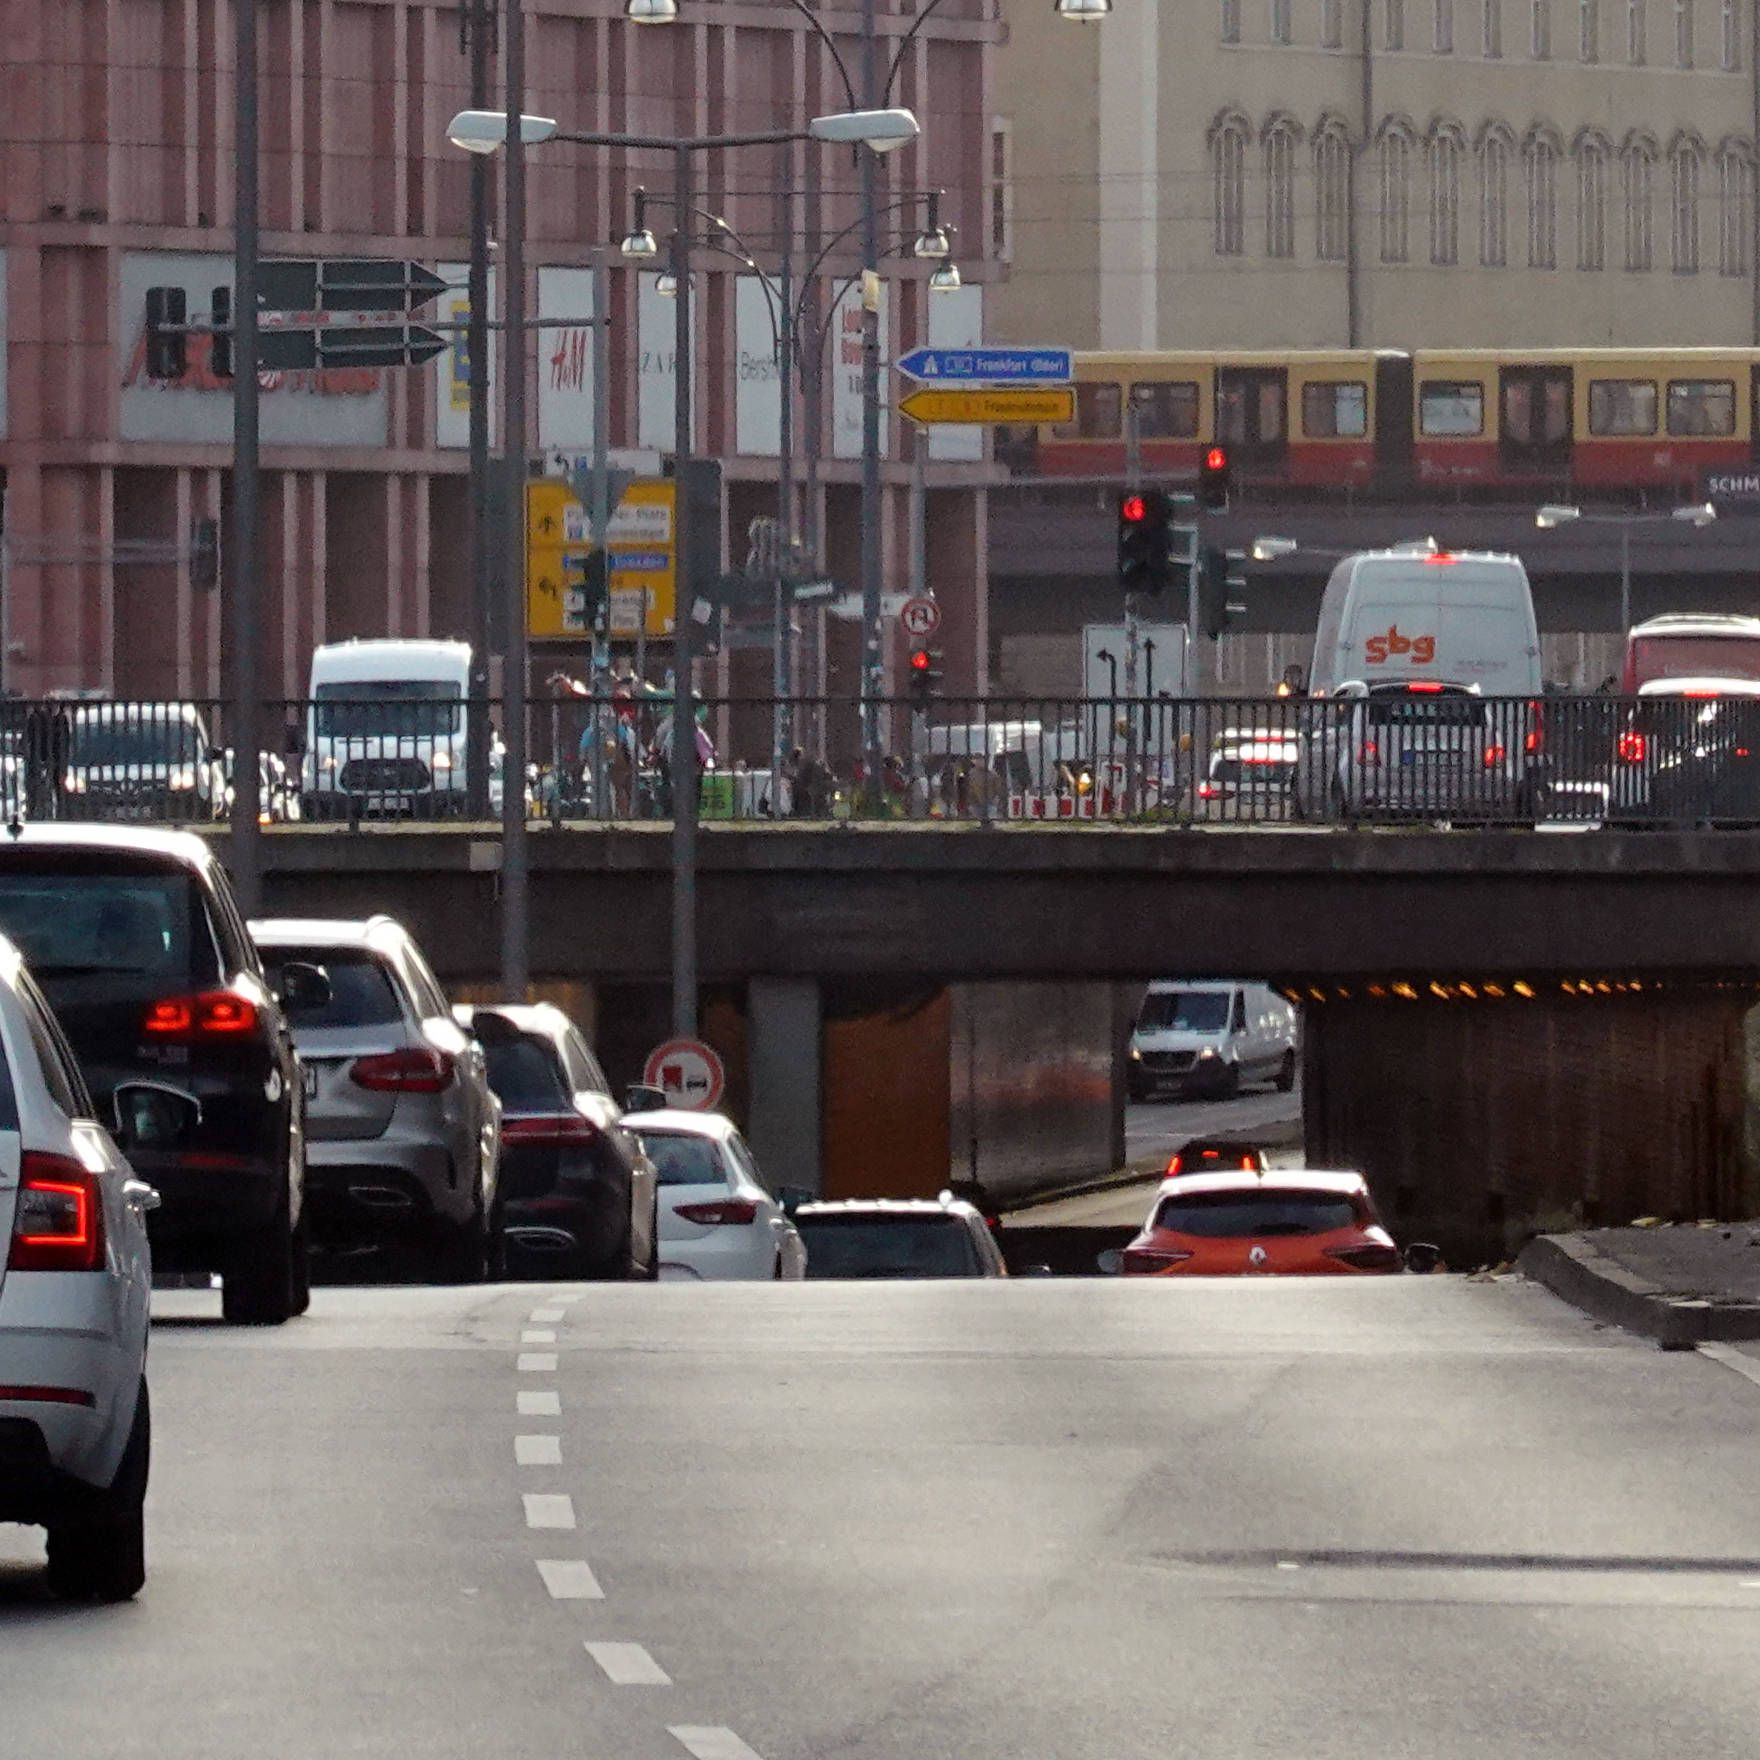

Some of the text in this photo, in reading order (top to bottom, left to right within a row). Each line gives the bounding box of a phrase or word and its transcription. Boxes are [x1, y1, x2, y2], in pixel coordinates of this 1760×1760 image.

[551, 329, 587, 392] H&M
[977, 357, 1027, 372] Frankfurt
[1365, 624, 1435, 664] sbg
